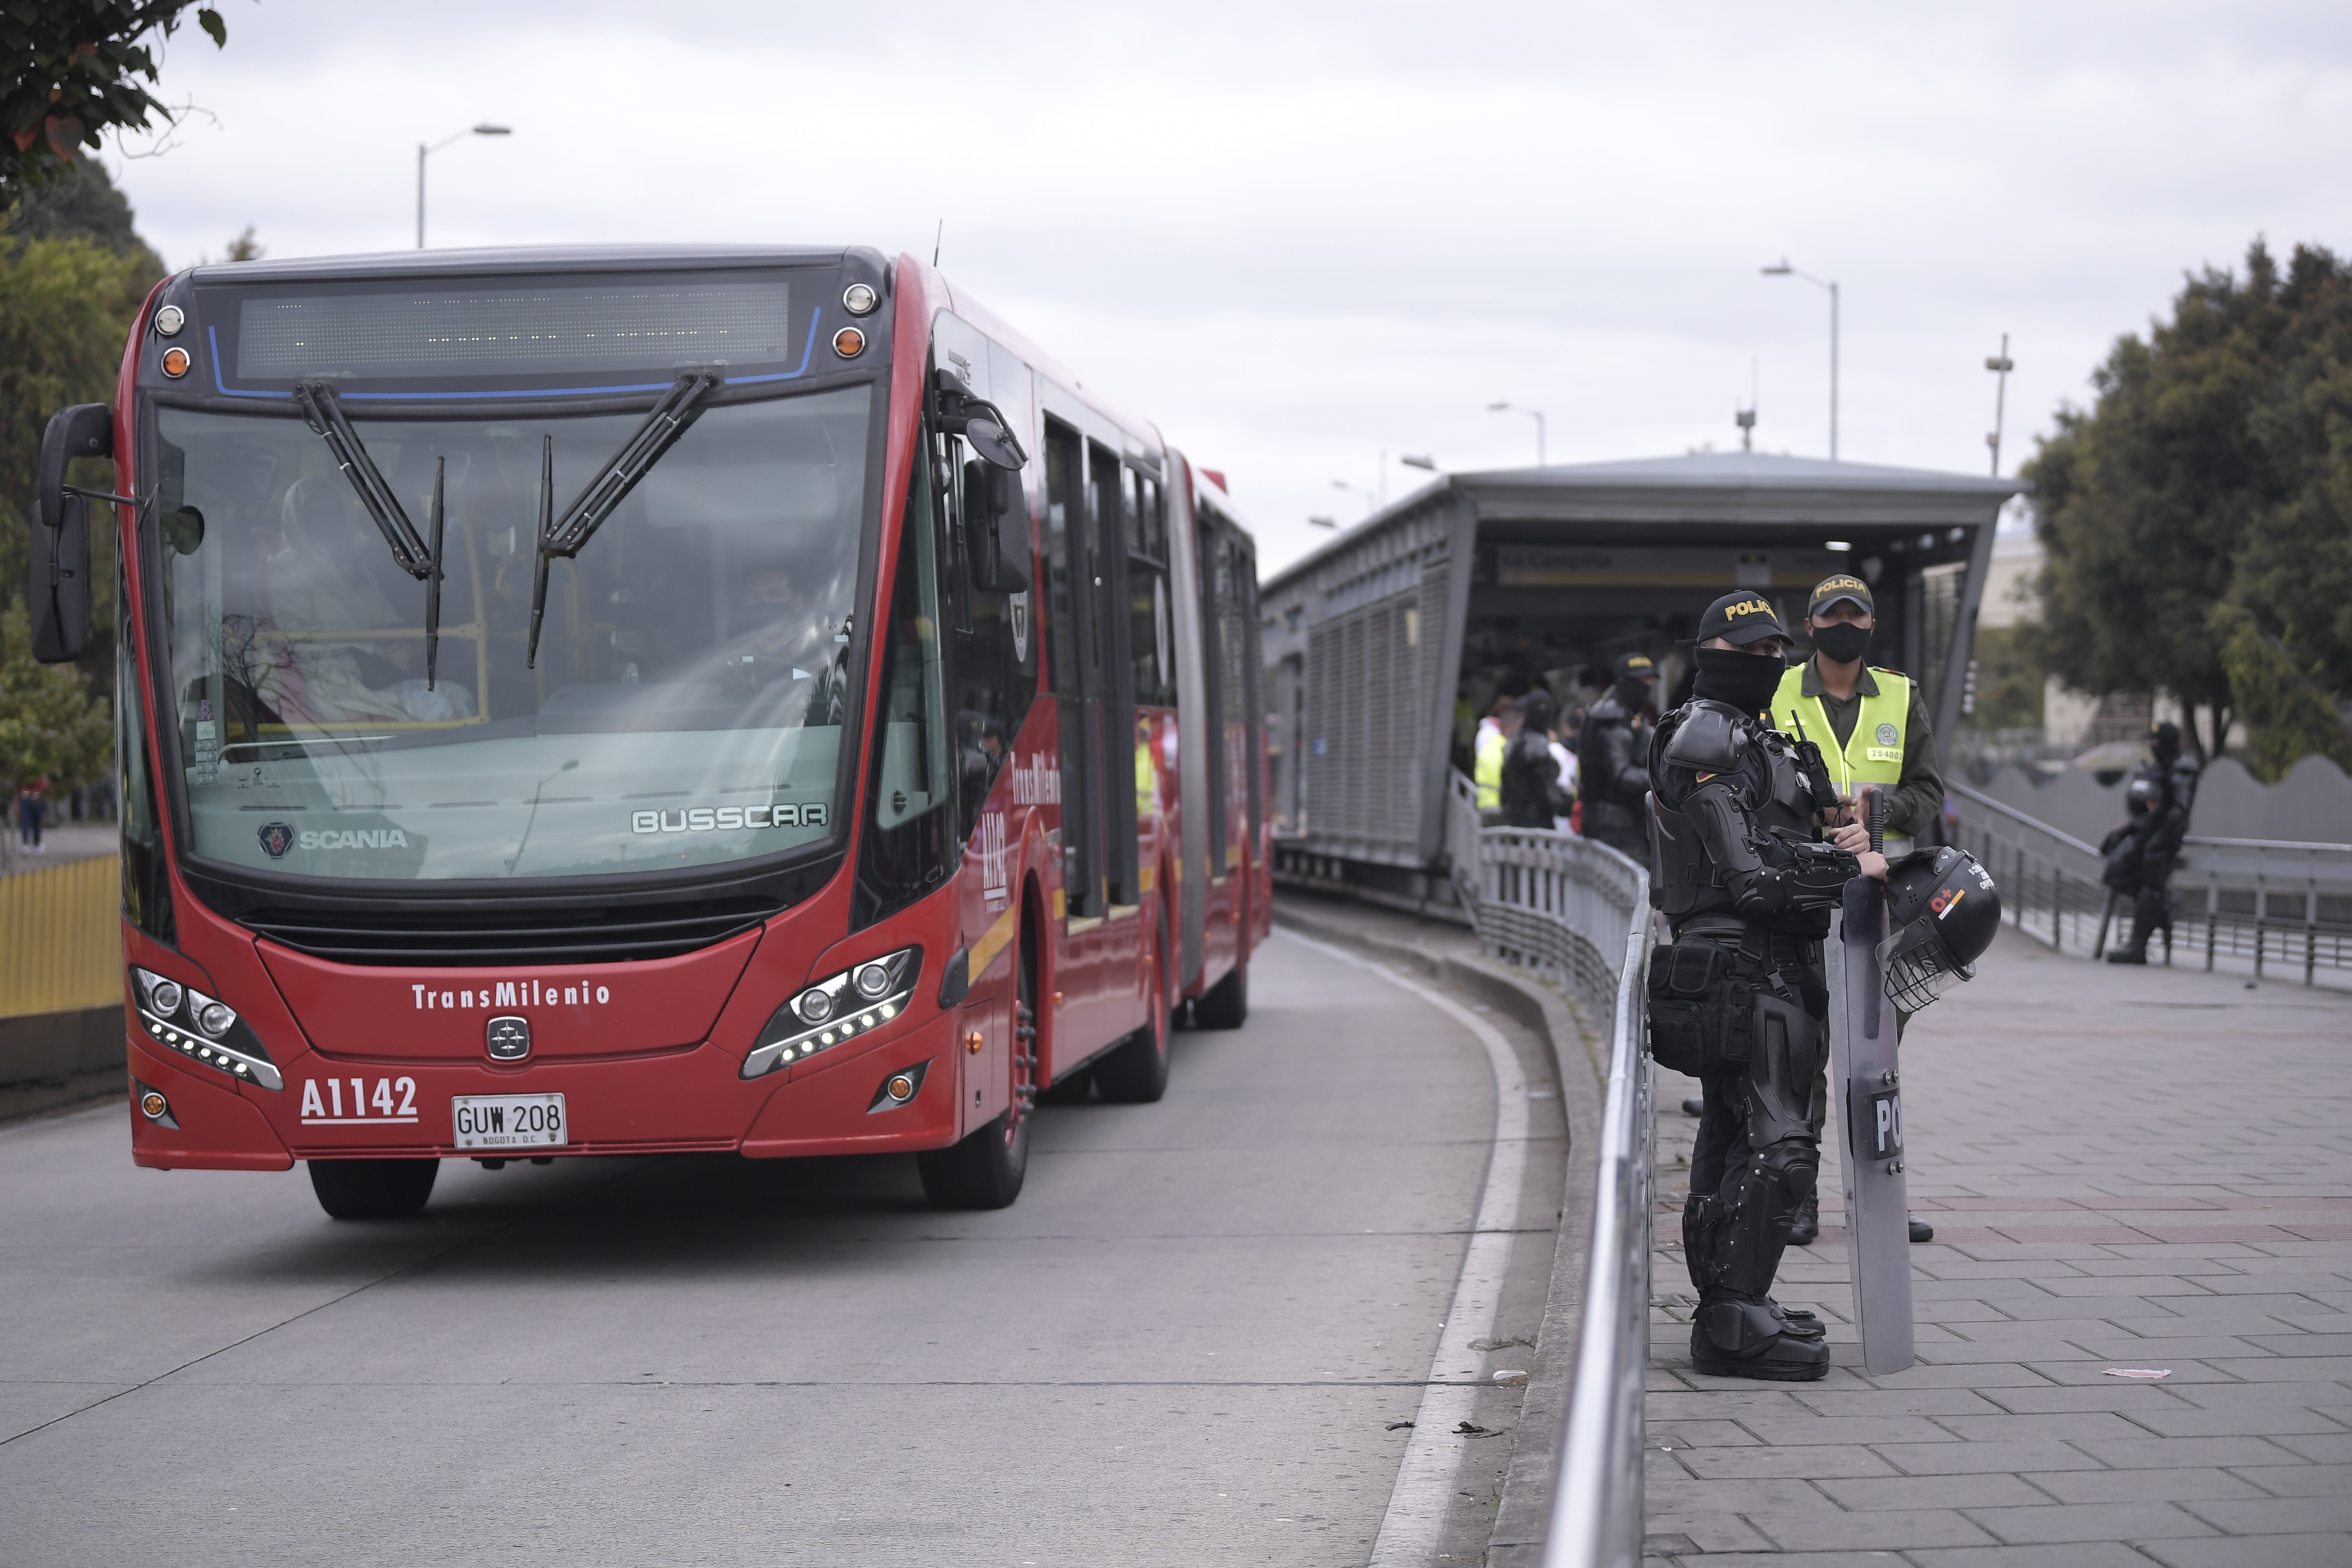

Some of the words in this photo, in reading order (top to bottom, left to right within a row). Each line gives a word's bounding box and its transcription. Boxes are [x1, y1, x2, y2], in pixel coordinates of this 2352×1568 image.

[1816, 579, 1866, 598] POLICIA
[1725, 599, 1778, 623] POLIC
[632, 803, 827, 833] BUSSCAR
[299, 829, 408, 850] SCANIA
[412, 979, 610, 1009] TransMilenio
[301, 1077, 417, 1116] A1142
[457, 1107, 504, 1134] GUW
[513, 1105, 561, 1132] 208
[483, 1135, 516, 1144] BOGOTA
